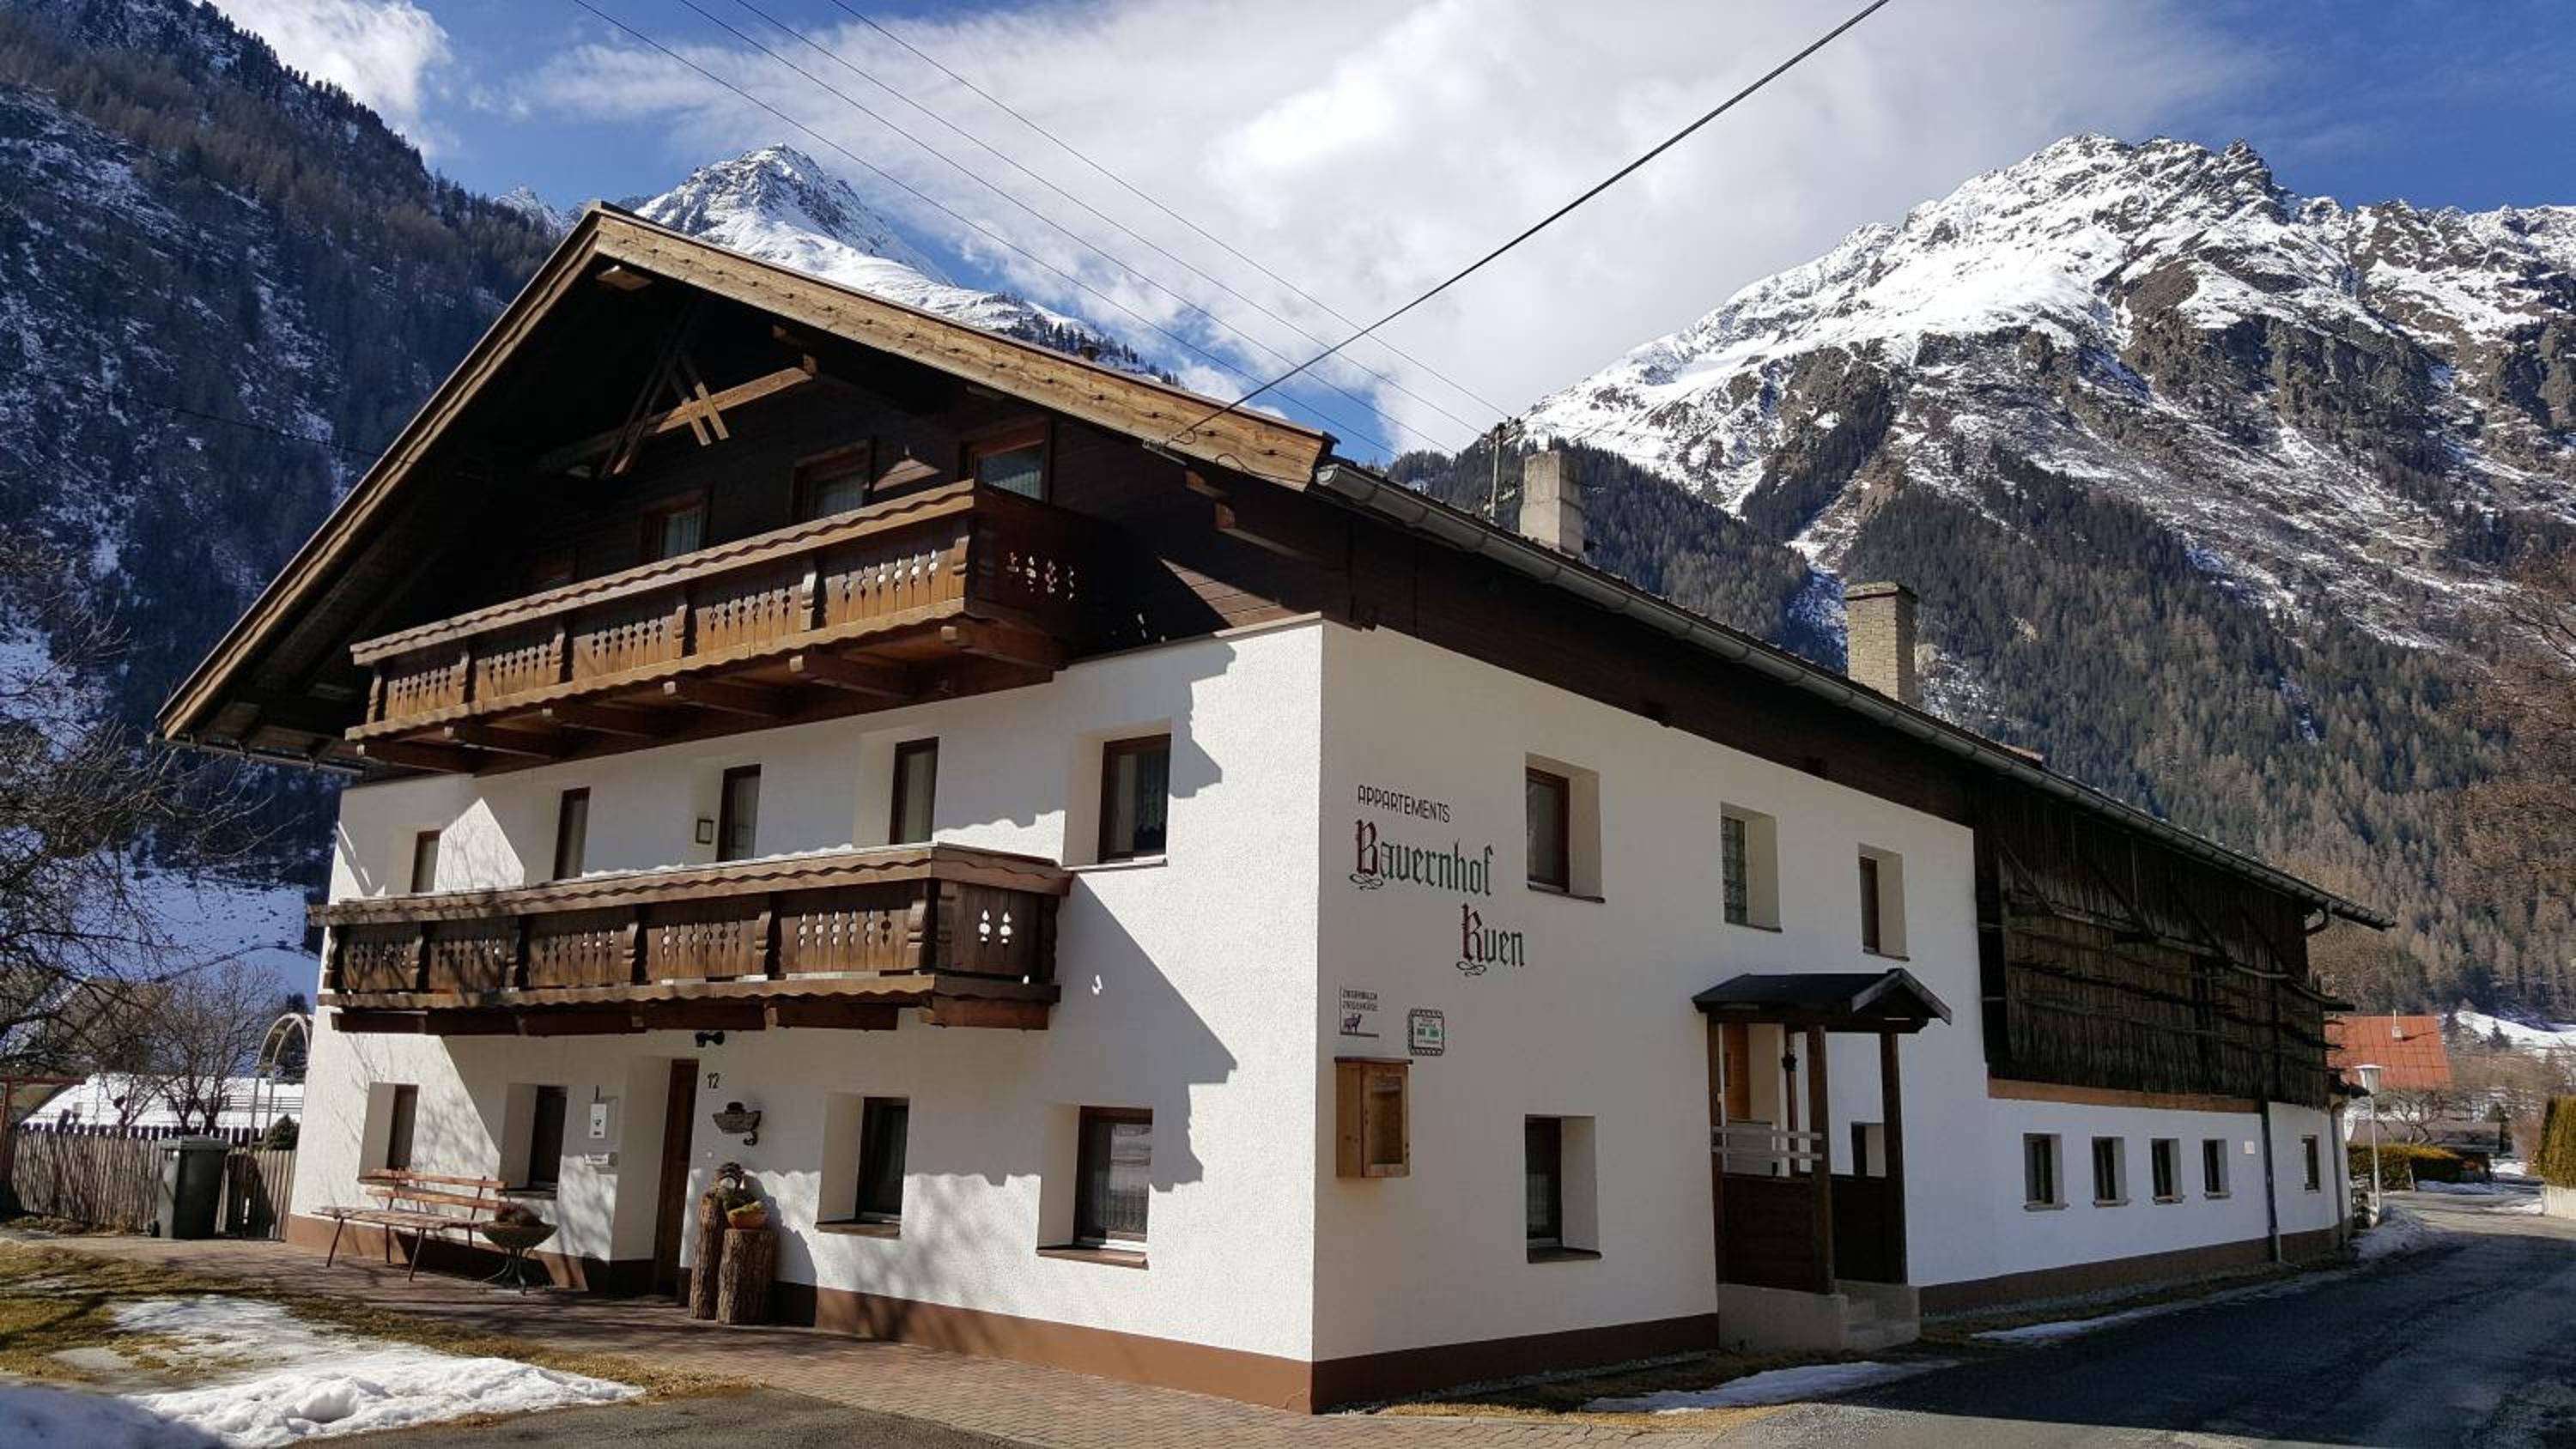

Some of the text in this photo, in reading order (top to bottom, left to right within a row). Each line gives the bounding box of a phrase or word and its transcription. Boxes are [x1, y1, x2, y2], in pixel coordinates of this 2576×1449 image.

[1358, 785, 1450, 823] APPARTEMENTS
[1355, 819, 1494, 896] Bauernhof
[707, 1072, 720, 1089] 12
